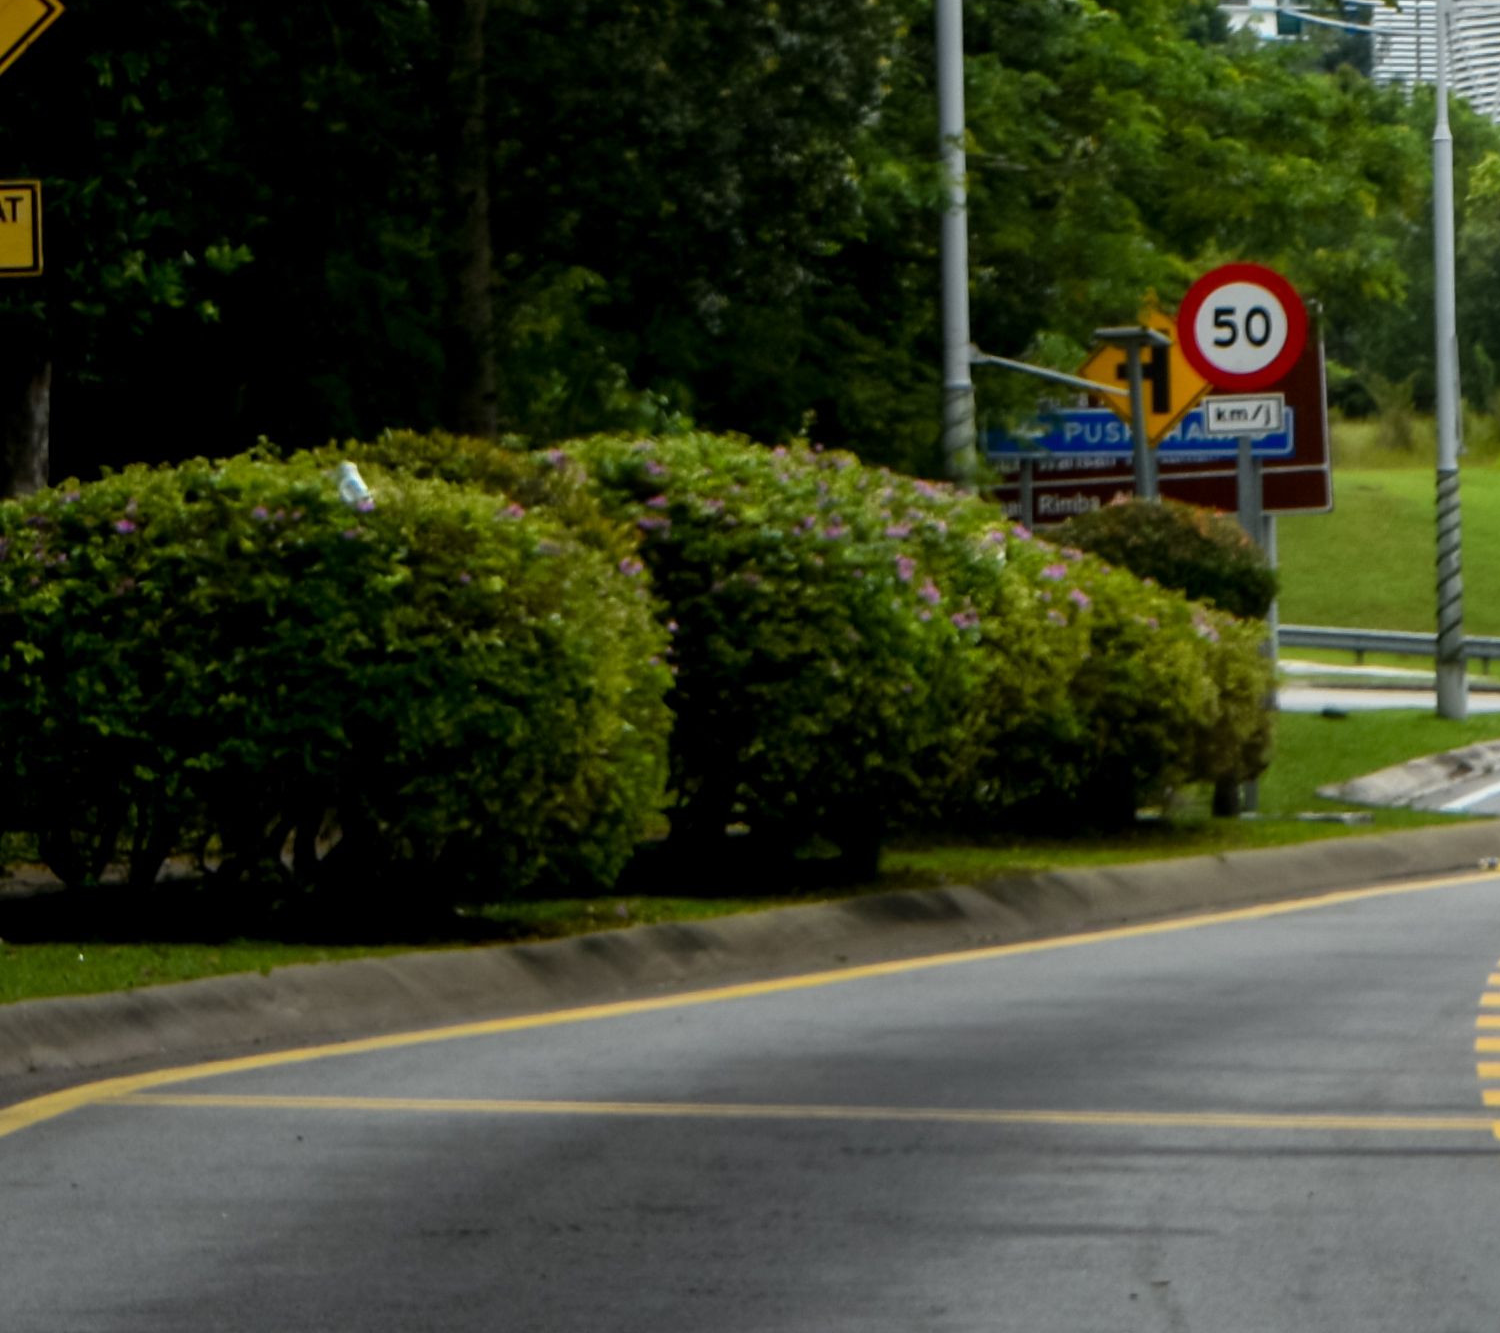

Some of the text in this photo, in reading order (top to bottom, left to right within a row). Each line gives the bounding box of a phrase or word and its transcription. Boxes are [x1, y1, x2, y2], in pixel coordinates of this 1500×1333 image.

[1212, 305, 1272, 348] 50
[1216, 404, 1272, 427] km/j
[1038, 490, 1101, 516] Rimba
